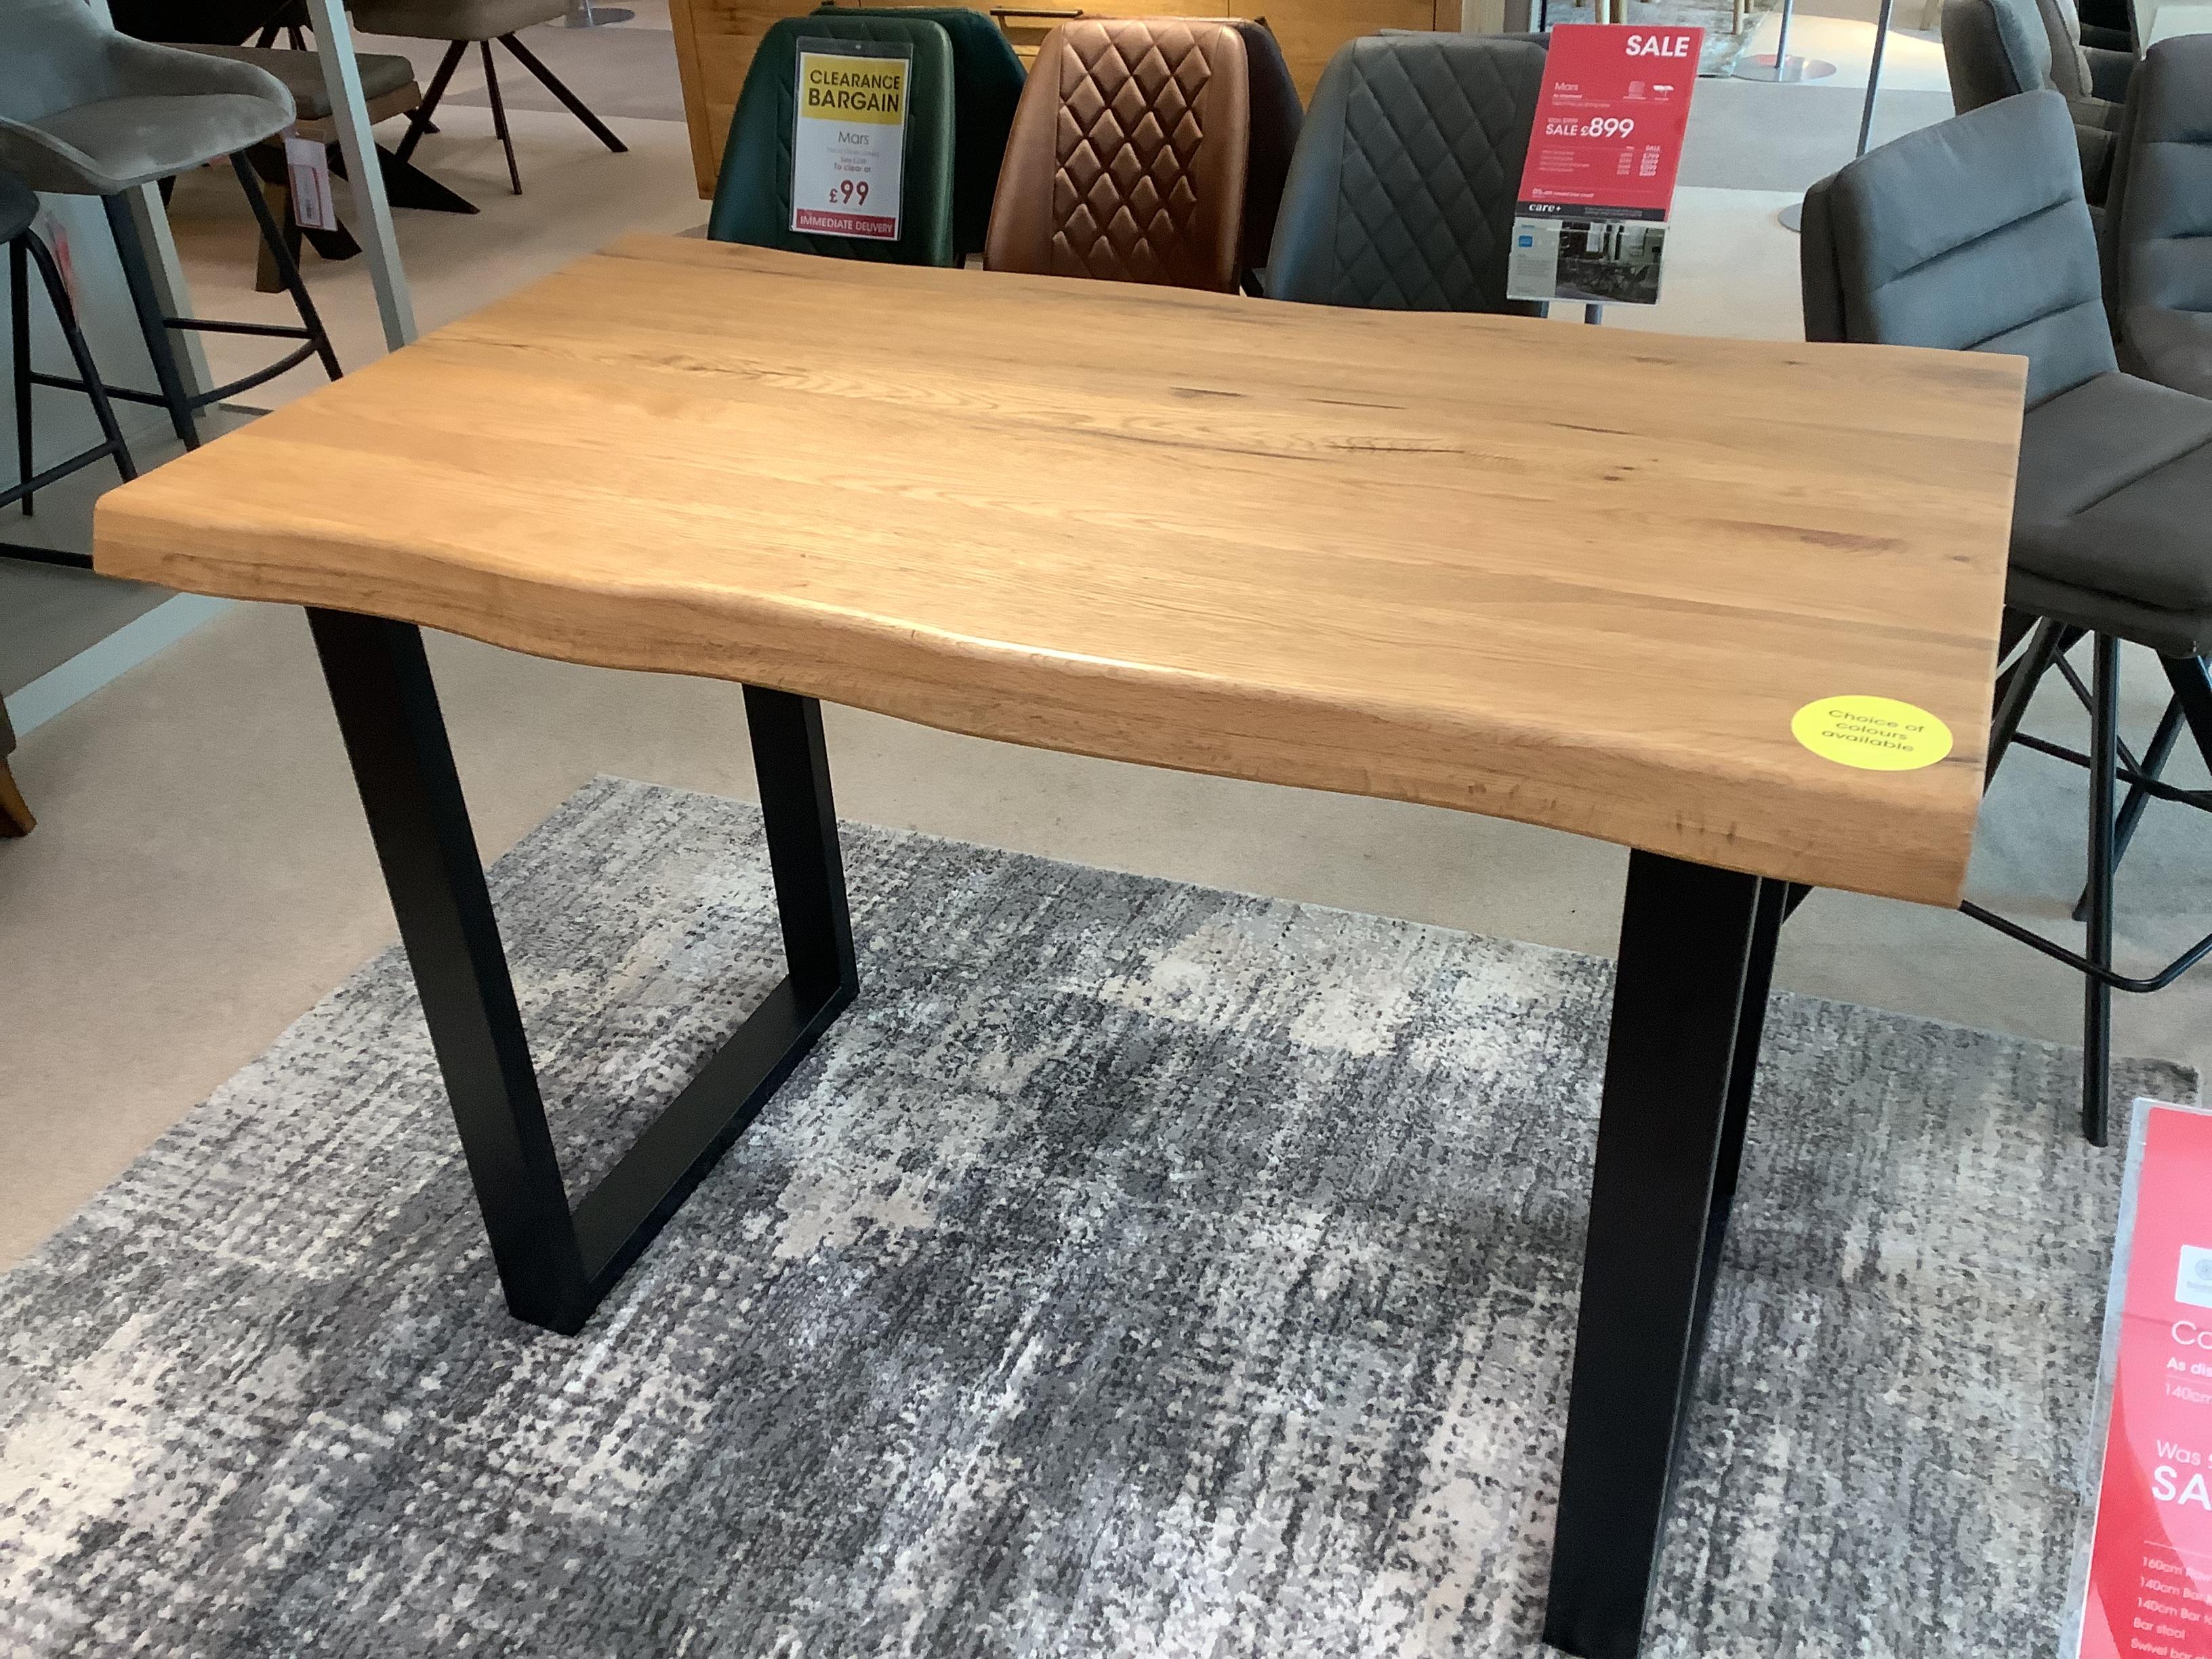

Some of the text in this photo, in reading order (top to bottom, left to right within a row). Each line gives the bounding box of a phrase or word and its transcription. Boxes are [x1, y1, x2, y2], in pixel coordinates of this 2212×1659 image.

[1626, 35, 1690, 58] SALE
[810, 69, 900, 90] CLEARANCE
[1555, 82, 1578, 91] Mars
[808, 88, 899, 112] BARGAIN
[838, 131, 869, 144] Mars
[1546, 117, 1635, 138] SALE £899
[830, 179, 869, 205] £99
[800, 216, 893, 233] IMMEDIATE DELIVERY
[1828, 710, 1924, 733] Choice of
[1836, 722, 1908, 740] colours
[1822, 730, 1914, 752] available
[2167, 1357, 2186, 1371] As
[2156, 1439, 2201, 1466] Was
[2152, 1465, 2212, 1511] SA
[2144, 1556, 2182, 1576] 160cm
[2140, 1576, 2180, 1595] 140cm
[2138, 1597, 2177, 1616] 140cm
[2180, 1607, 2201, 1622] Bar
[2133, 1617, 2154, 1631] Bar
